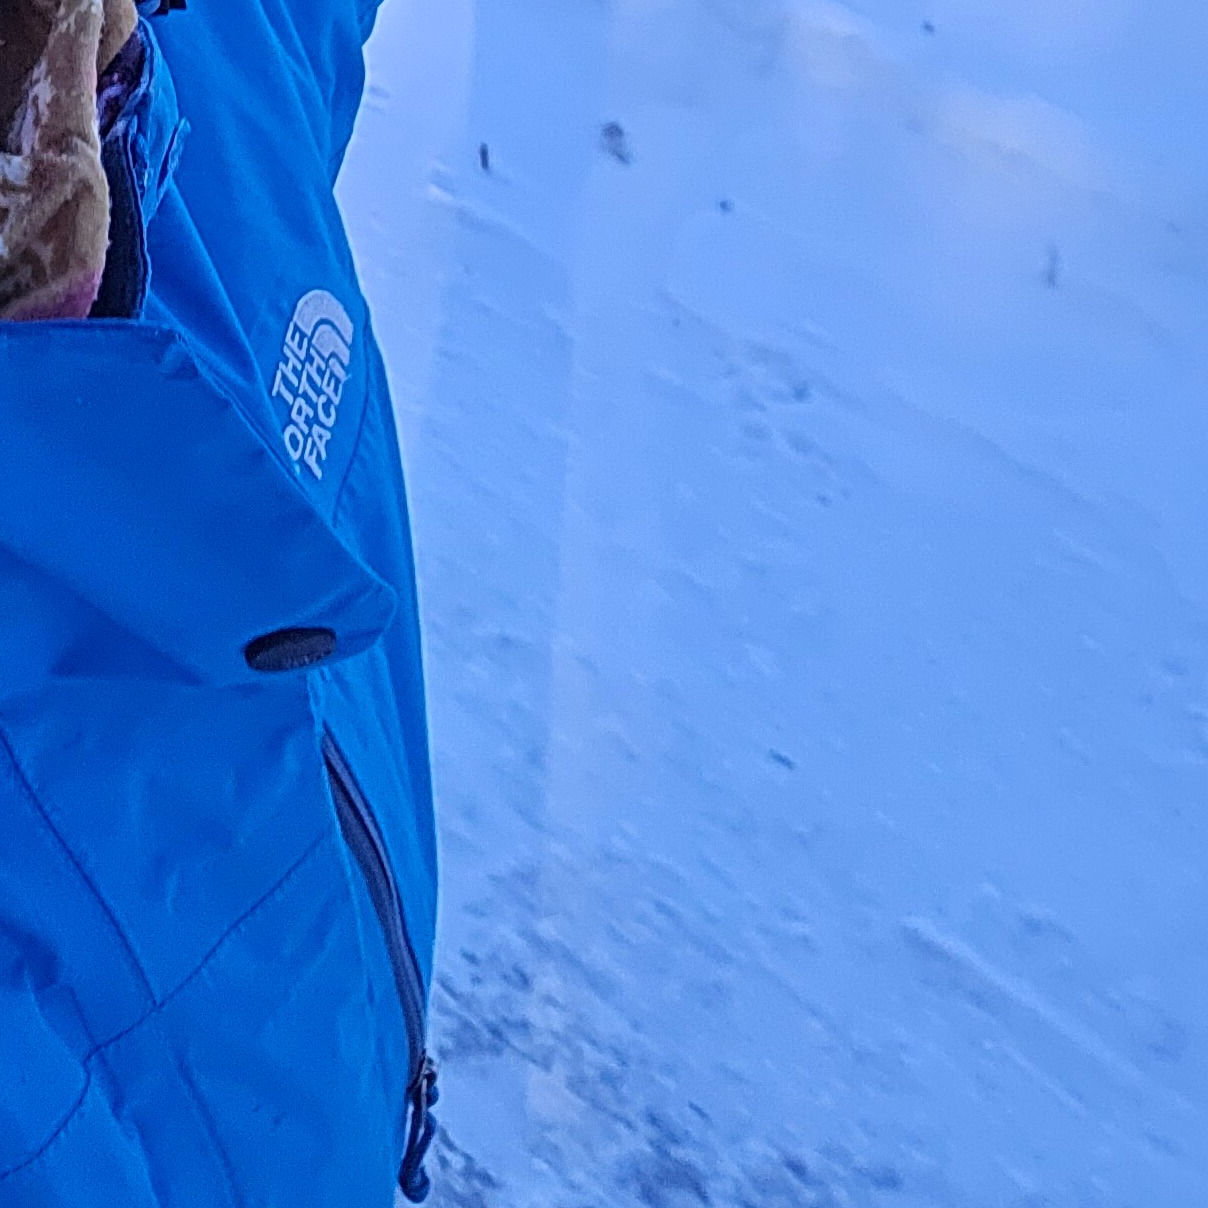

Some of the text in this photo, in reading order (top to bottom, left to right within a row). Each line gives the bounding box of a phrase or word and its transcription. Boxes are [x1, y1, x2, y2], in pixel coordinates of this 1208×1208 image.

[272, 320, 308, 405] THE
[284, 347, 326, 475] ORTH
[304, 368, 342, 480] FACE
